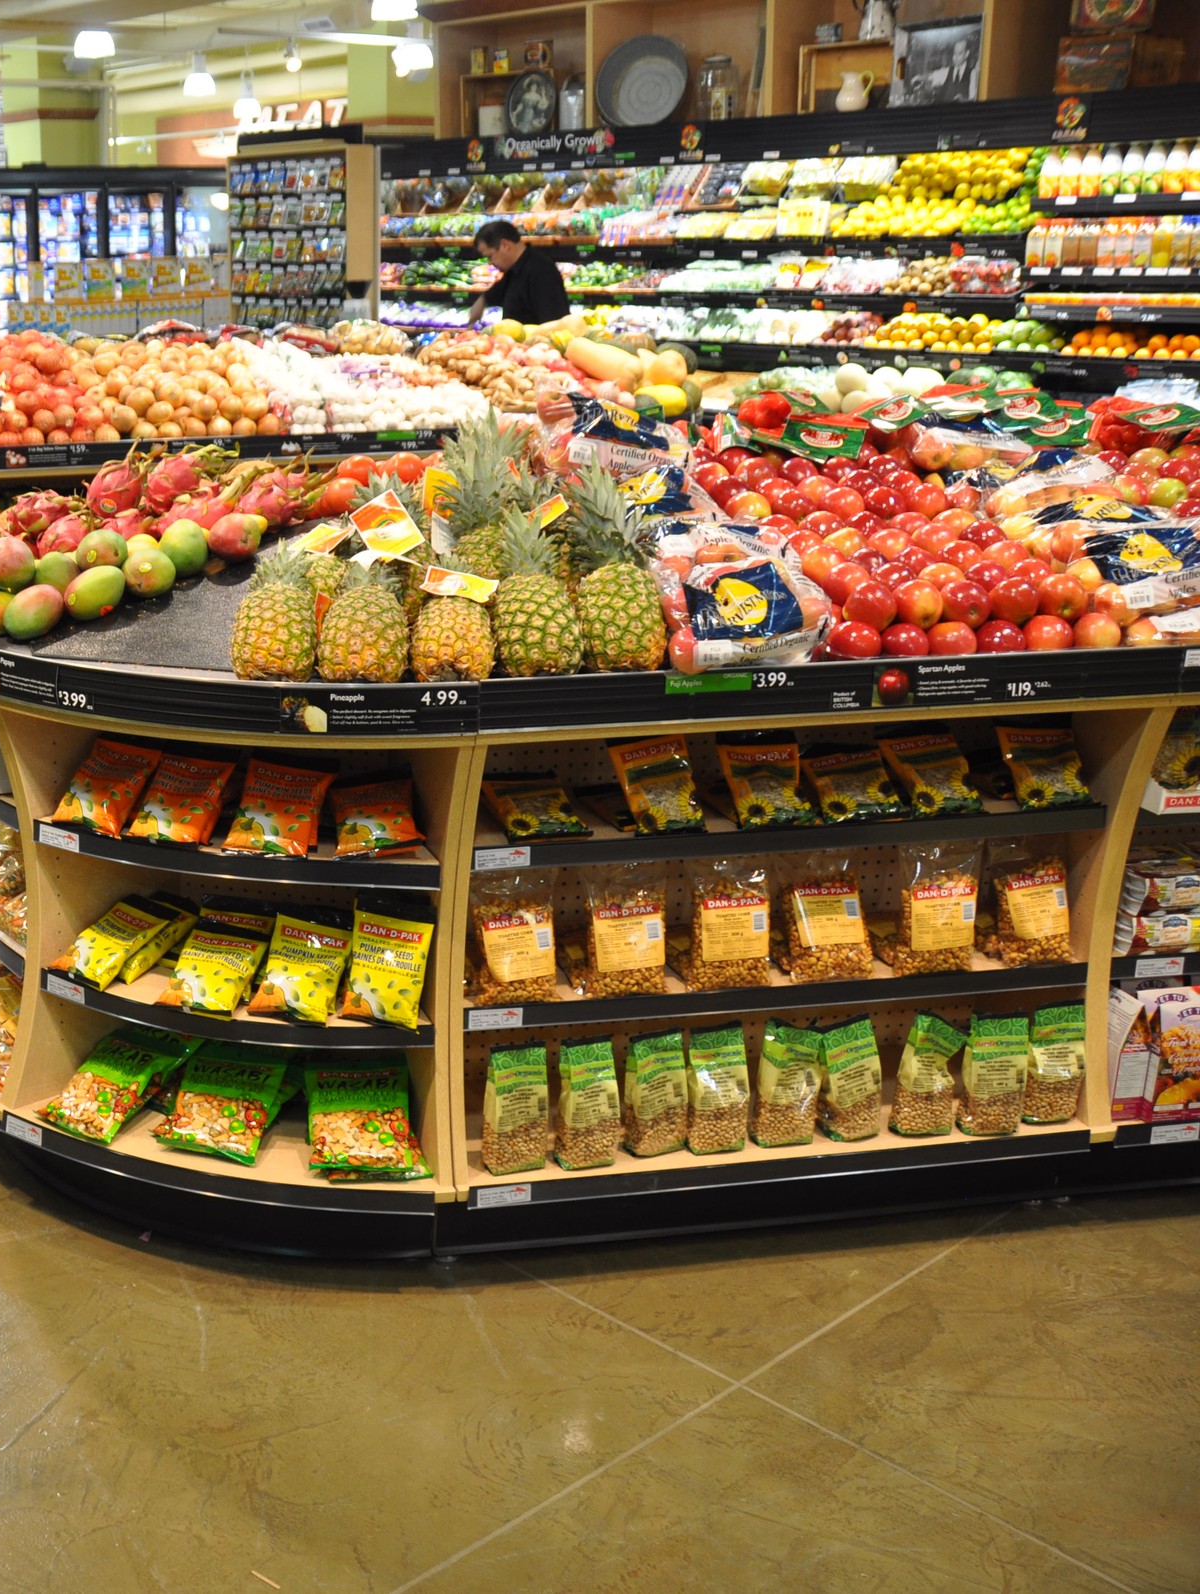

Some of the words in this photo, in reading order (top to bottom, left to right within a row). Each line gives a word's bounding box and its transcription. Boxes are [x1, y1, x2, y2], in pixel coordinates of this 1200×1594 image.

[506, 136, 562, 151] Organically
[565, 133, 603, 147] Grown
[610, 444, 646, 461] Certified
[1164, 570, 1200, 584] Certifie
[1168, 584, 1196, 599] Apples
[743, 638, 779, 654] Certified
[780, 633, 810, 648] Organic
[0, 657, 15, 668] Papaya
[918, 665, 943, 674] Spartan
[943, 664, 966, 673] Apples
[682, 679, 702, 688] Apples
[752, 672, 787, 688] $3.99
[1007, 682, 1032, 697] $1.19
[58, 691, 87, 708] $3.99
[330, 693, 365, 702] Pineapple
[420, 690, 459, 706] 4.99
[224, 950, 246, 963] SEEDS
[282, 945, 315, 960] PUMPKIN
[359, 942, 394, 958] PUMPKN
[394, 949, 415, 960] SEEDS
[215, 954, 250, 973] CITROUILLE
[306, 958, 342, 974] CITROUILLE
